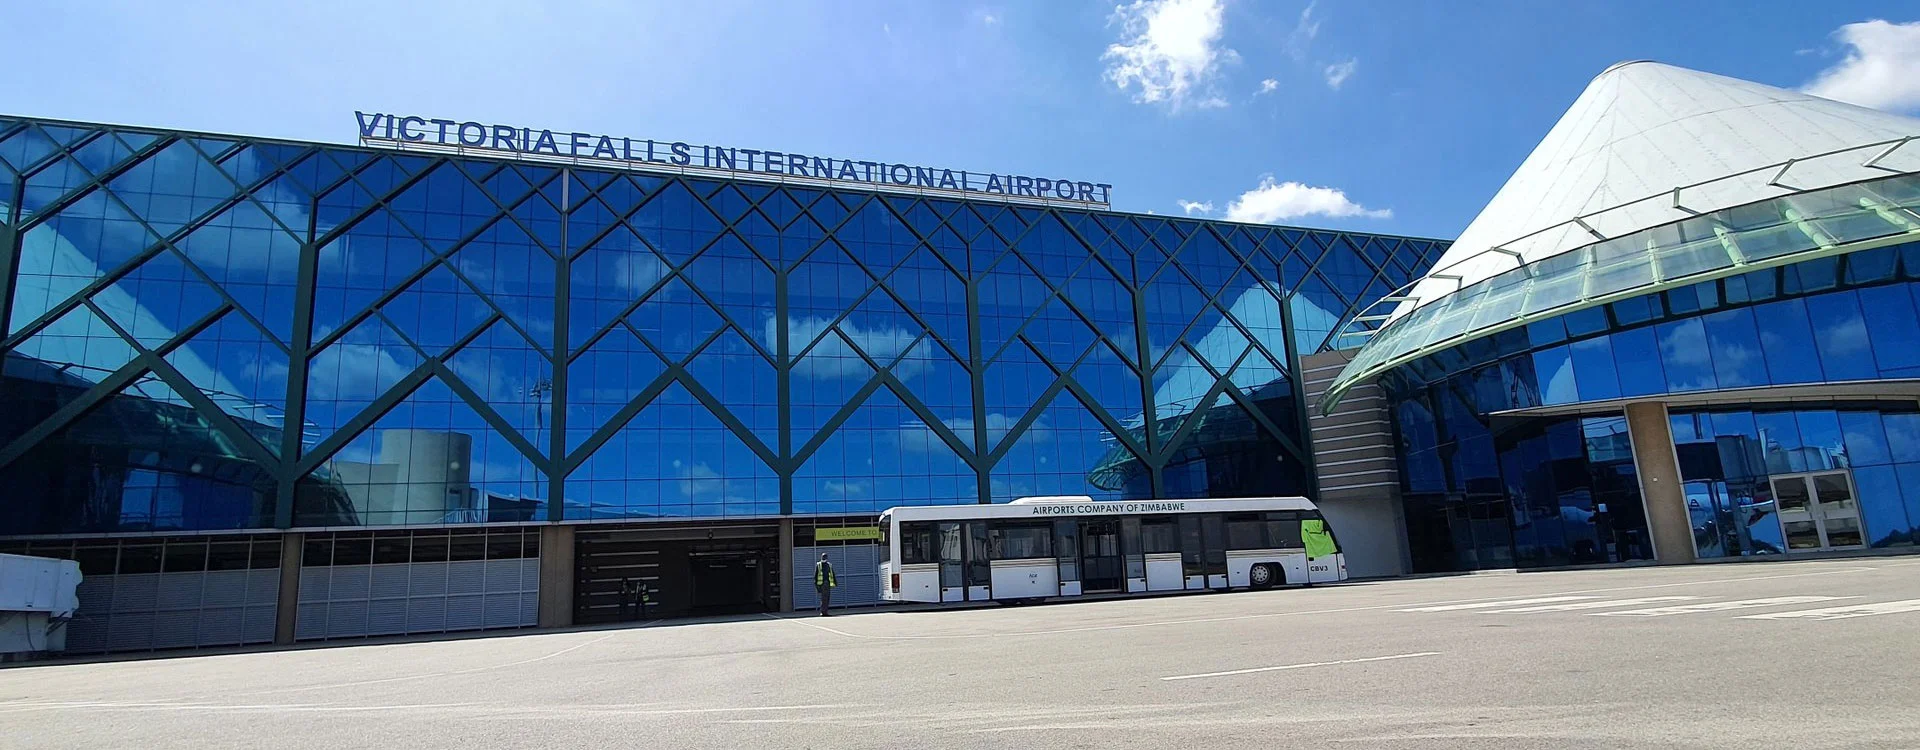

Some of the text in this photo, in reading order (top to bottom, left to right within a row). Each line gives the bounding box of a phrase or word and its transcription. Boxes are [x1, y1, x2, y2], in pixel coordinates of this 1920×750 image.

[355, 111, 1112, 204] VICTORIA FALLS INTERNATIONAL AIRPORT
[1032, 502, 1185, 515] AIRPORTS COMPANY OF ZIMBABWE
